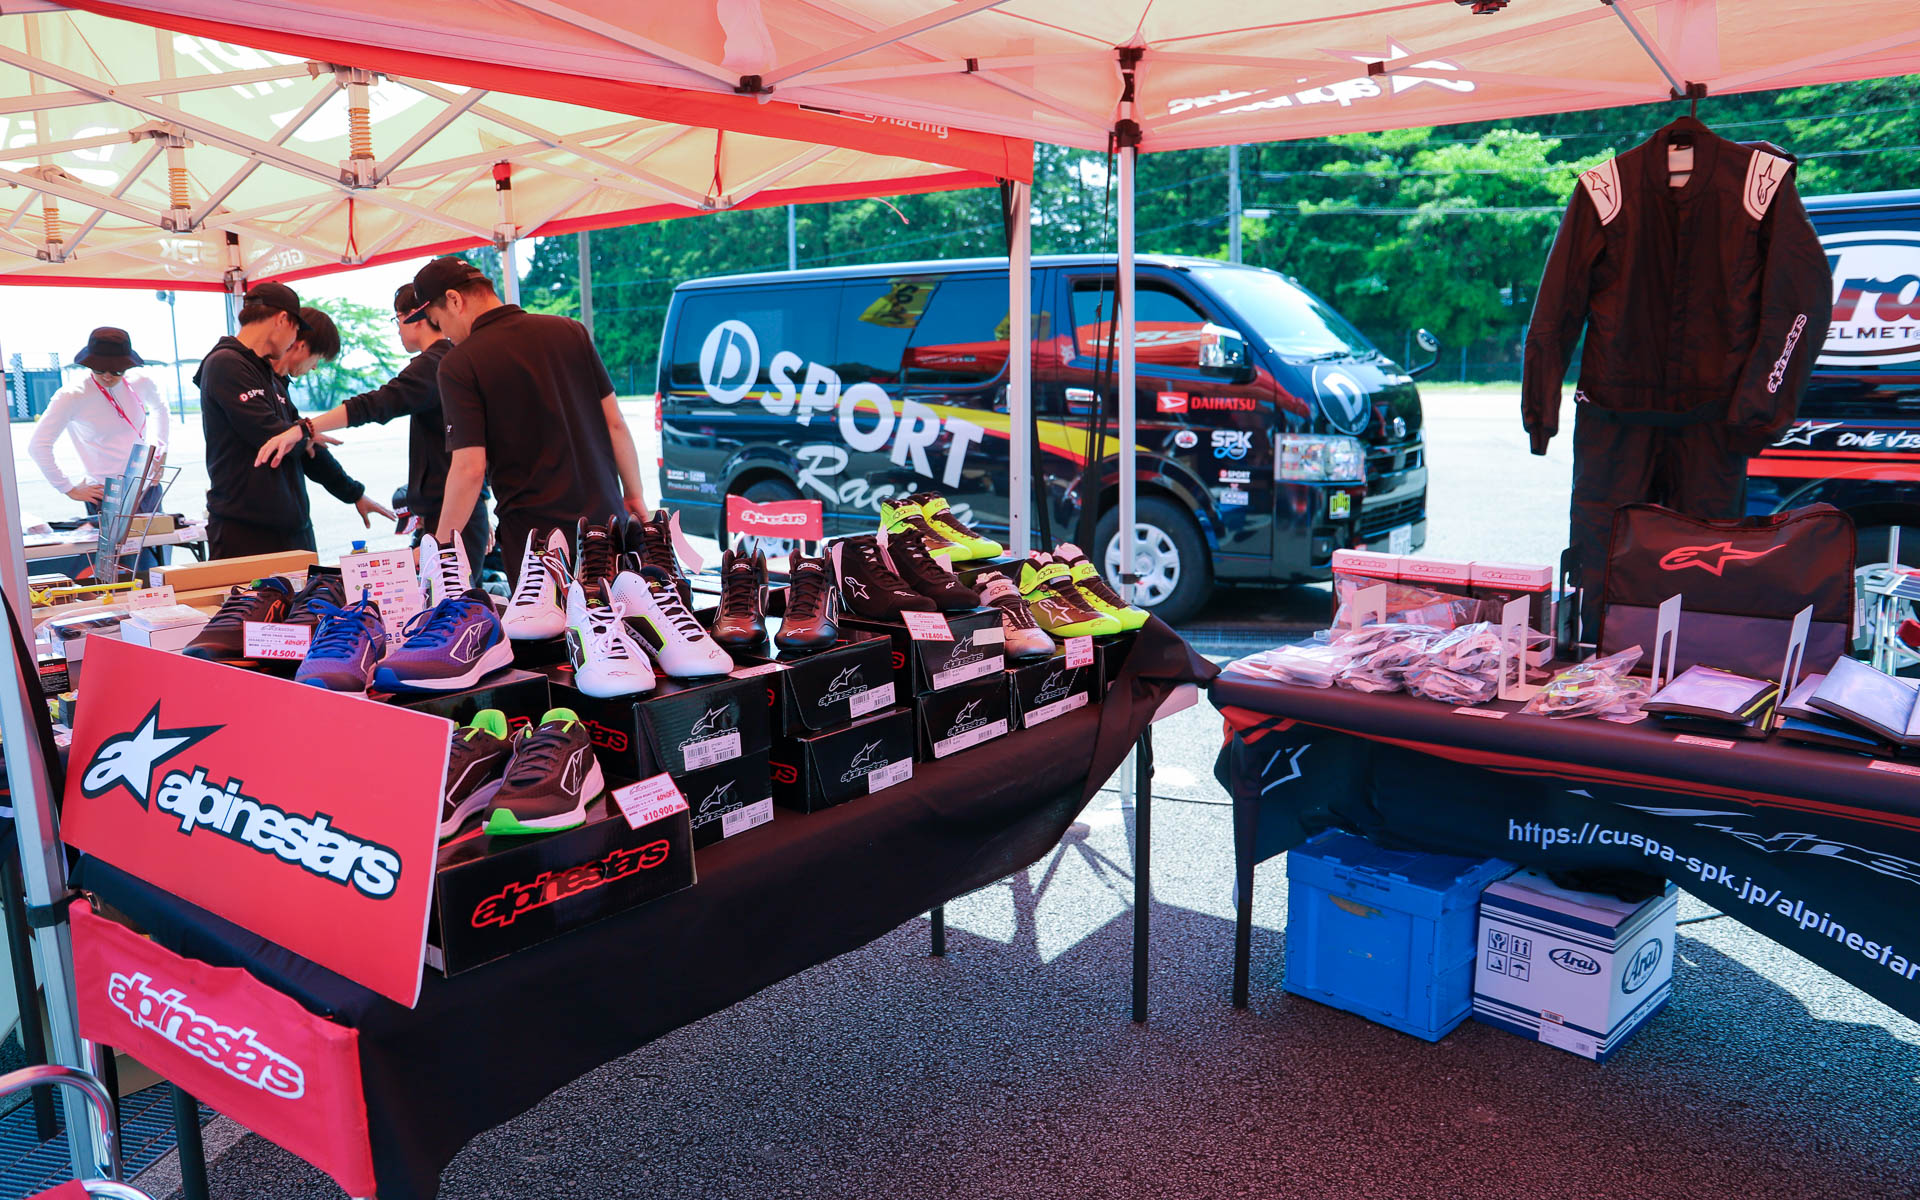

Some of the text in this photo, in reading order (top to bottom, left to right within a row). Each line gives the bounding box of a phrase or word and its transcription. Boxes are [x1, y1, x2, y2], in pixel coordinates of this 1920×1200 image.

[1828, 326, 1915, 339] ELMET
[1190, 397, 1256, 411] DAIHATSU
[760, 350, 985, 489] SPORT
[1211, 431, 1253, 449] SPK
[1837, 432, 1886, 448] ONE
[1227, 470, 1250, 480] SPORT
[156, 765, 403, 899] alpinestars
[471, 839, 670, 928] alpinestars
[1558, 951, 1596, 971] Arai
[1630, 942, 1659, 981] Arai
[108, 971, 305, 1100] alpinestars
